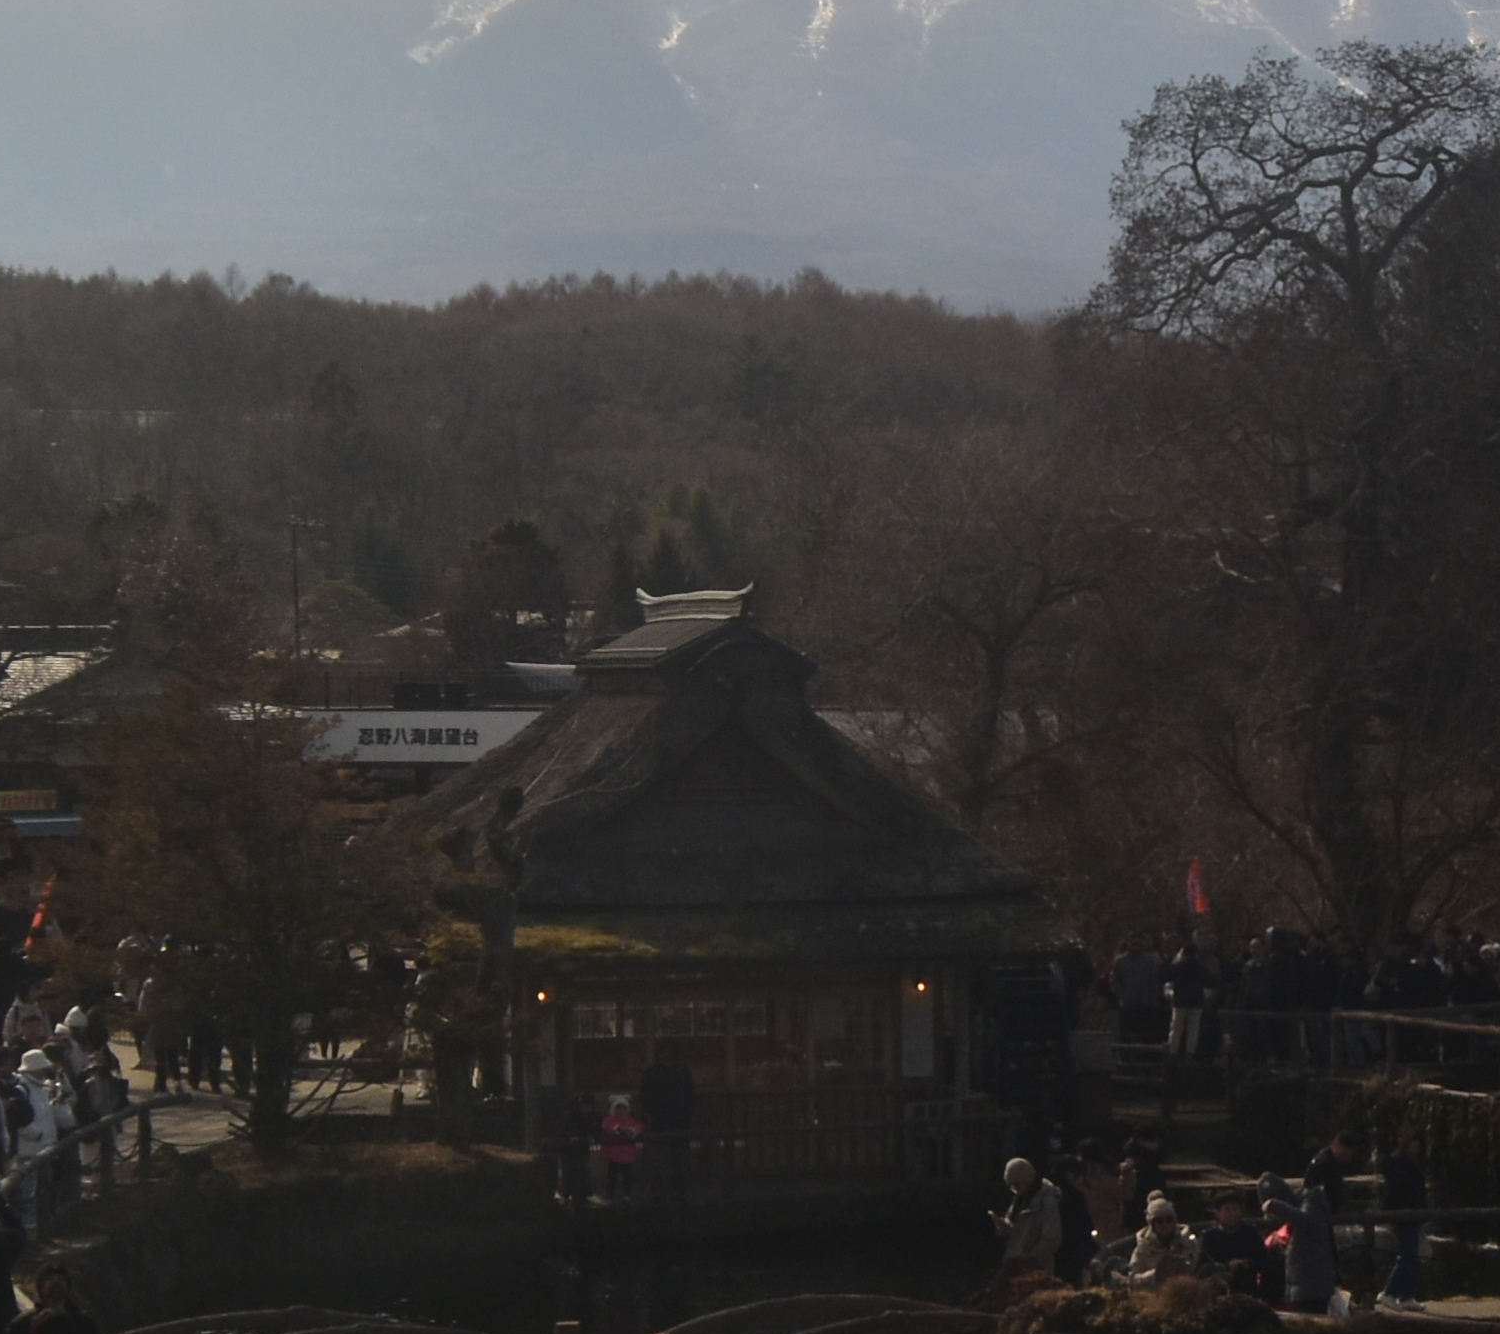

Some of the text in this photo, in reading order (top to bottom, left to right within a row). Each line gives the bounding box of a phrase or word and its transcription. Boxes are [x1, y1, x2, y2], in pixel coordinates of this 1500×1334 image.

[358, 728, 479, 746] 忍野八海展望台
